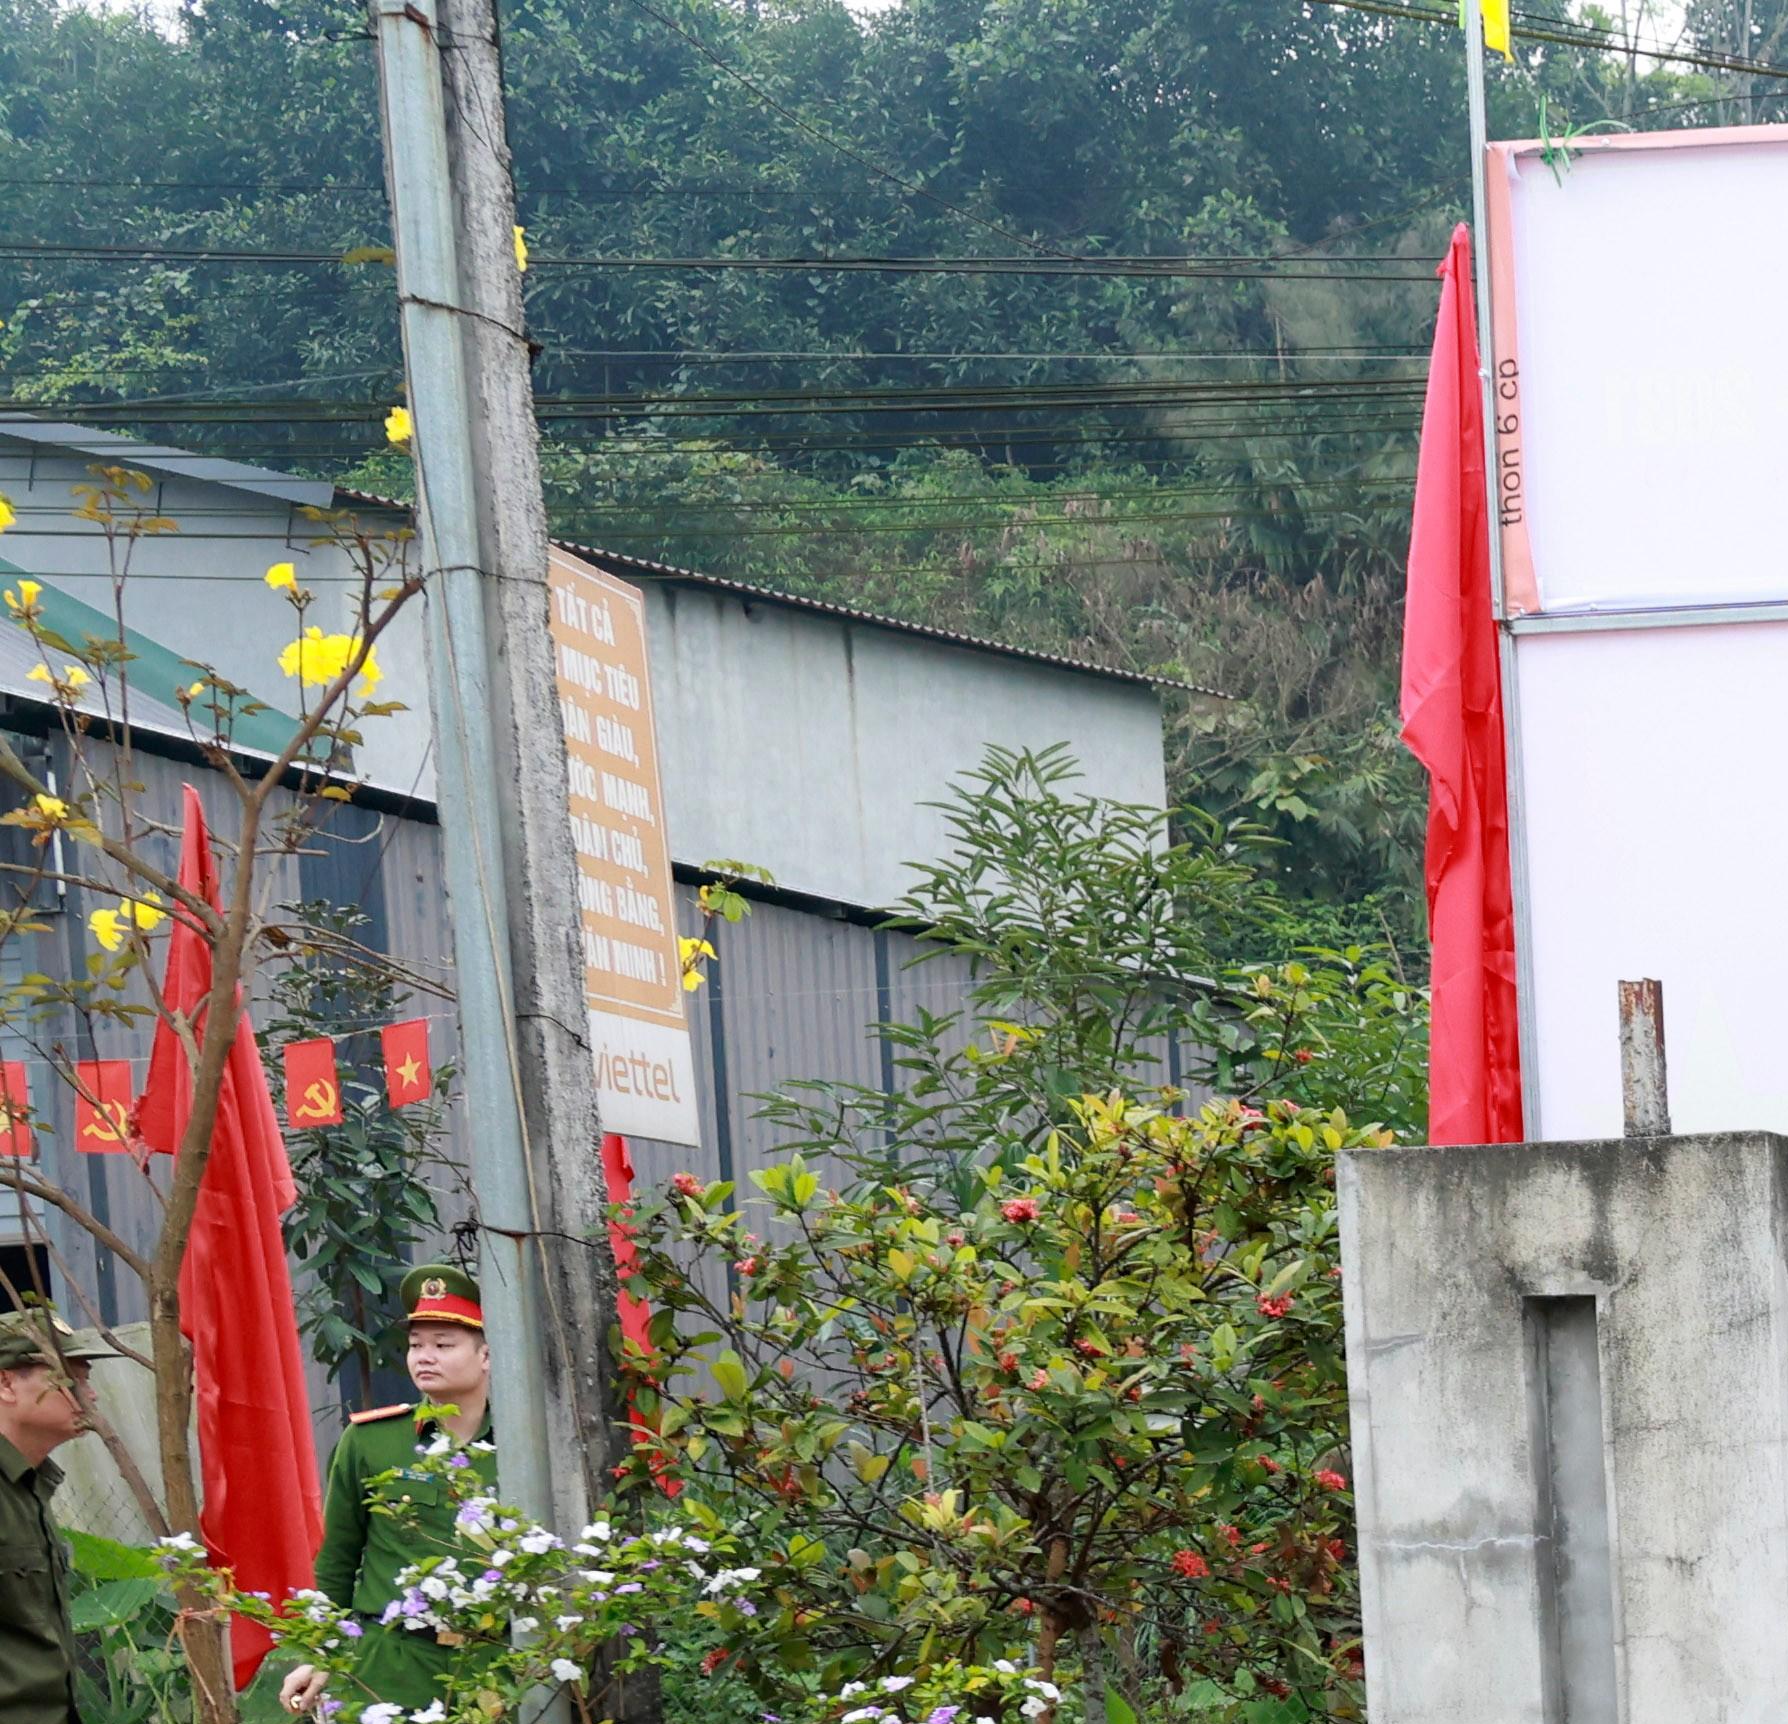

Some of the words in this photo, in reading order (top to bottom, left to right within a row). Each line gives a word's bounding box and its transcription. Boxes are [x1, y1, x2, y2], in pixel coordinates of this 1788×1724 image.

[1498, 358, 1519, 400] cp
[1497, 413, 1519, 435] 6
[1501, 448, 1522, 527] thon
[555, 582, 588, 634] TẤT
[590, 597, 616, 647] CẢ
[560, 643, 602, 697] MỤC
[603, 663, 640, 711] TIÊU
[596, 713, 640, 768] GIÀU,
[602, 771, 656, 828] MẠNH,
[611, 825, 649, 879] CHỦ,
[577, 865, 613, 918] ÔNG
[615, 875, 665, 937] BẰNG,
[580, 924, 611, 972] ĂN
[612, 938, 658, 985] MINH
